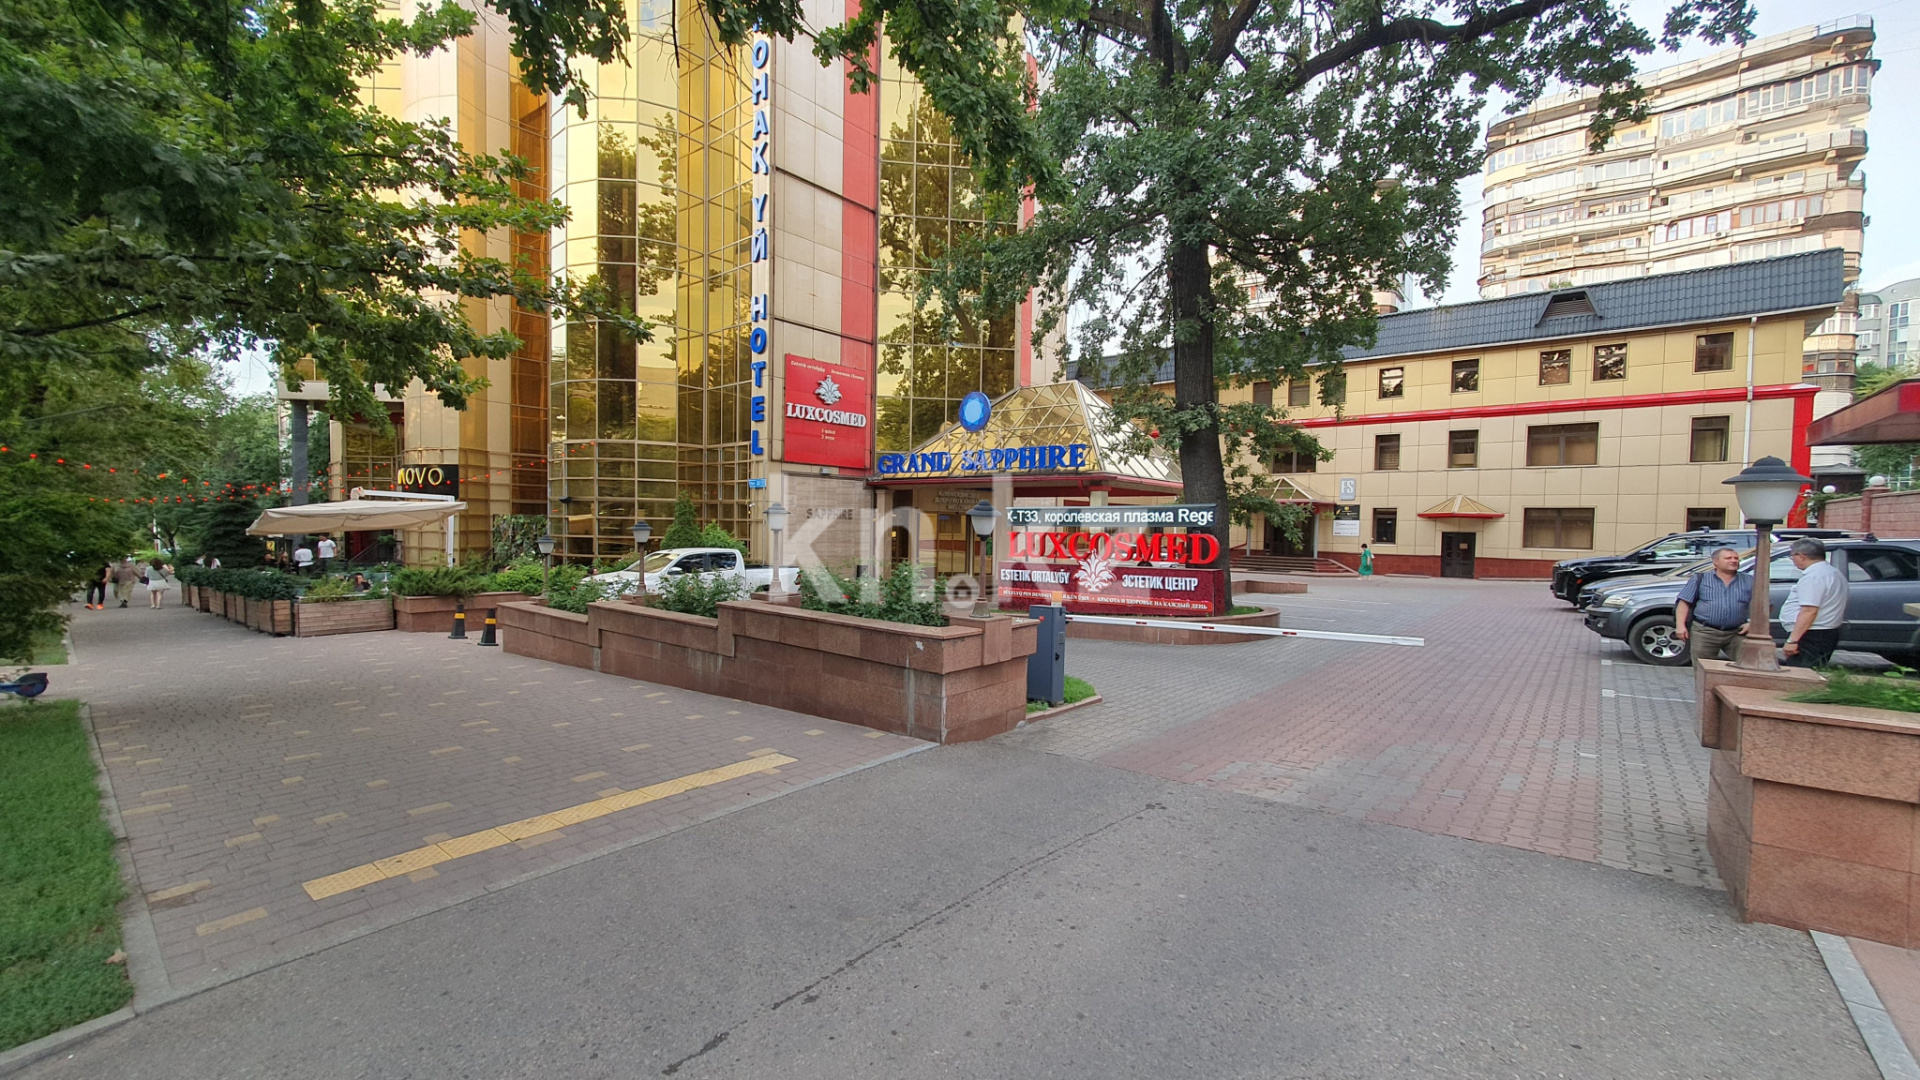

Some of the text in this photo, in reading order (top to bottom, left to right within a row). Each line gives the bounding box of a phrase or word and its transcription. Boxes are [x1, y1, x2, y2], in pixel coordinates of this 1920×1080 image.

[750, 293, 768, 456] HOTEL
[786, 402, 866, 428] LUXCOSMED
[878, 443, 1087, 474] GRAND SAPPHIRE
[806, 507, 853, 520] SAPPHIRE
[1044, 511, 1120, 526] королевская
[1123, 511, 1174, 523] плазма
[1007, 531, 1220, 565] LUXCOSMED
[1000, 569, 1031, 582] ESTETIK
[1122, 574, 1198, 591] ЭСТЕТИК ЦЕНТР
